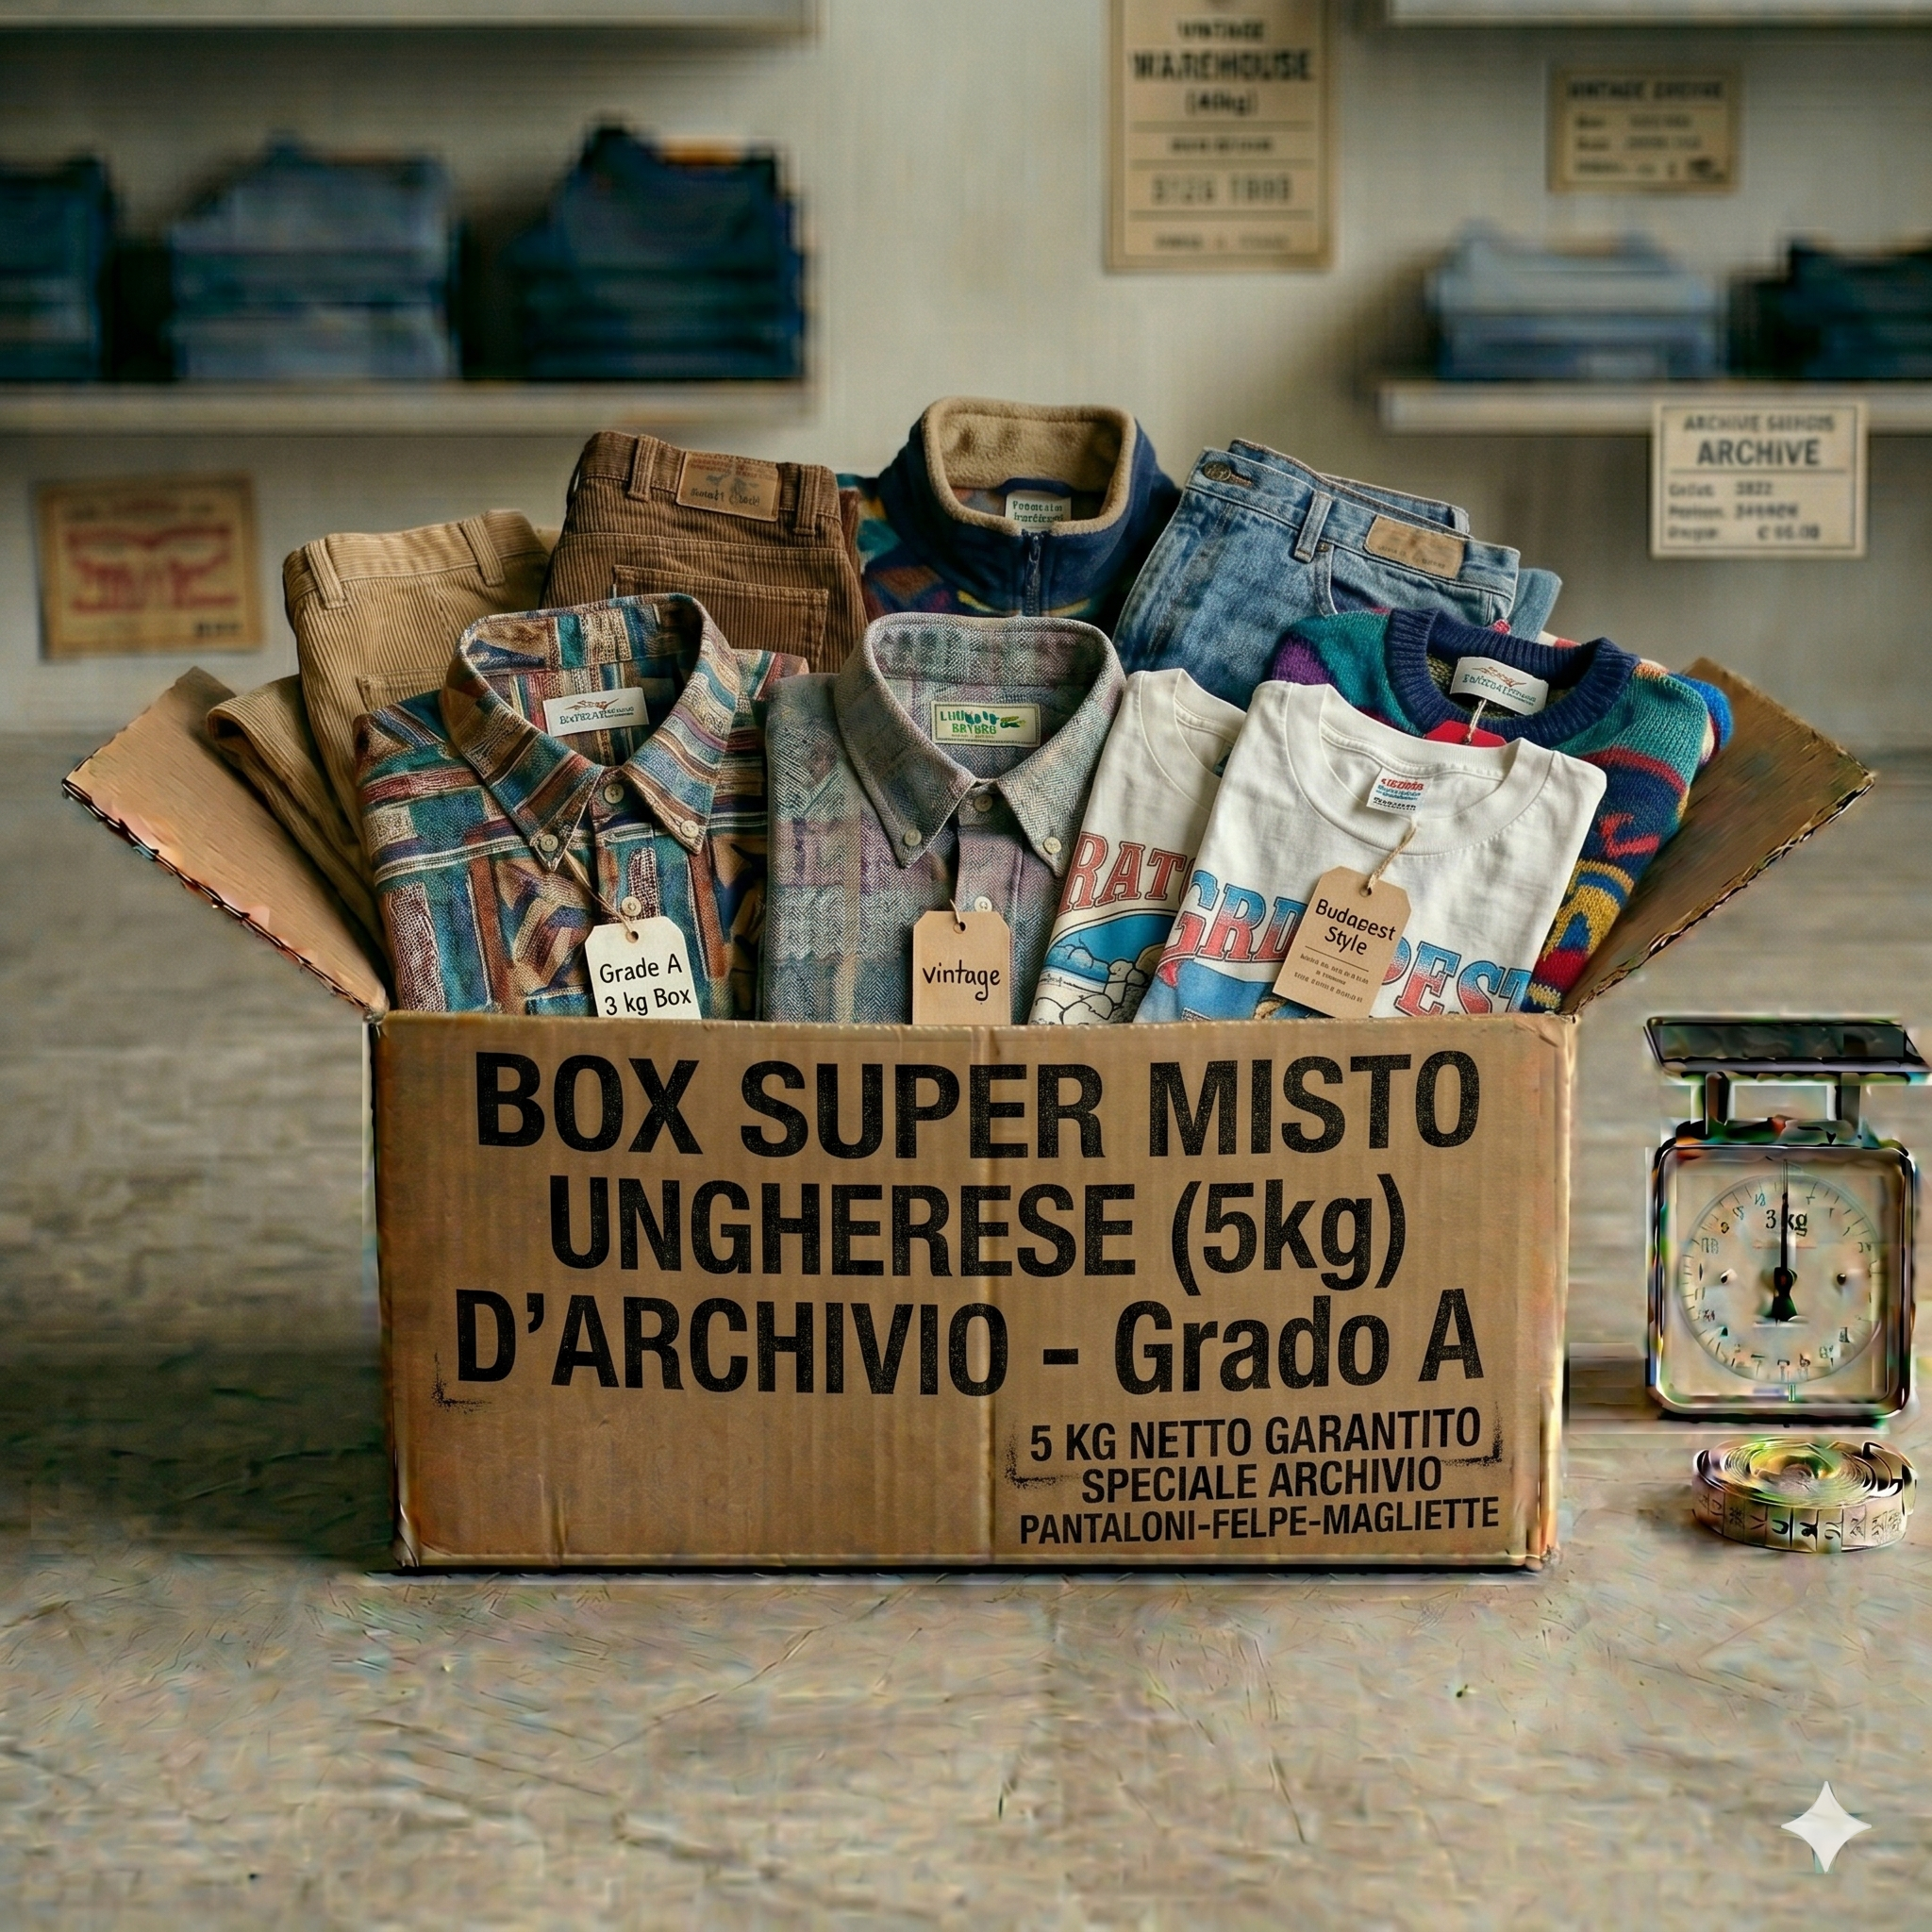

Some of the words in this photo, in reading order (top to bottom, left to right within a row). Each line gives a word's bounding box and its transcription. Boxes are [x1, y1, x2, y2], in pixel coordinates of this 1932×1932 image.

[1133, 51, 1311, 81] WAREHOUSE
[1698, 439, 1820, 465] ARCHIVE
[1054, 831, 1196, 919] RAT
[1324, 926, 1368, 956] Style
[599, 957, 659, 983] Grade
[667, 953, 682, 974] A
[605, 996, 617, 1015] 3
[624, 991, 648, 1016] kg
[653, 988, 691, 1008] Box
[475, 1052, 703, 1155] BOX
[740, 1060, 1105, 1158] SUPER
[1149, 1050, 1480, 1158] MISTO
[550, 1175, 1136, 1277] UNGHERESE
[1172, 1174, 1406, 1296] (5kg)
[1765, 1208, 1777, 1229] 3
[1042, 1348, 1079, 1366] -
[1114, 1295, 1391, 1396] Grado
[1418, 1288, 1485, 1383] A
[1030, 1424, 1053, 1462] 5
[1066, 1423, 1116, 1462] KG
[1131, 1417, 1252, 1458] NETTO
[1264, 1406, 1481, 1454] GARANTITO
[1082, 1463, 1257, 1504] SPECIALE
[1268, 1456, 1442, 1498] ARCHIVIO
[1020, 1496, 1500, 1545] PANTALONI-FELPE-MAGLIETTE
